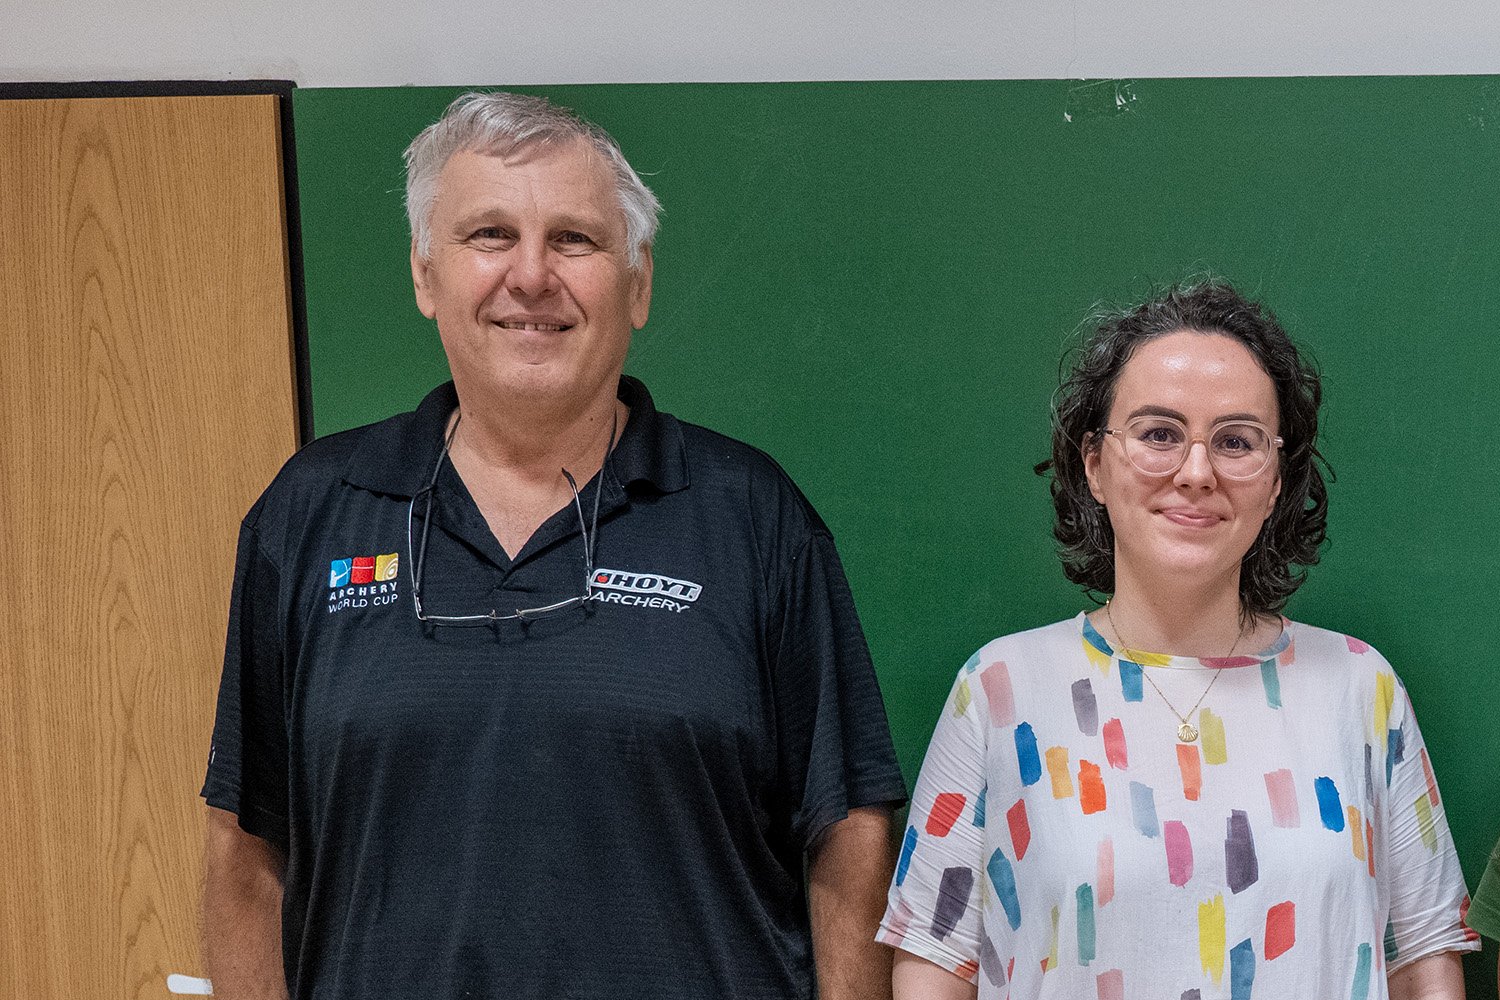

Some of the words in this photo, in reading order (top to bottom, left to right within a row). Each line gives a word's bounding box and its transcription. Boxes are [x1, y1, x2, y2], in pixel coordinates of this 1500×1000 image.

[329, 582, 397, 601] ARCHERY
[329, 598, 368, 613] WORLD
[373, 594, 398, 606] CUP
[590, 591, 690, 613] ARCHERY
